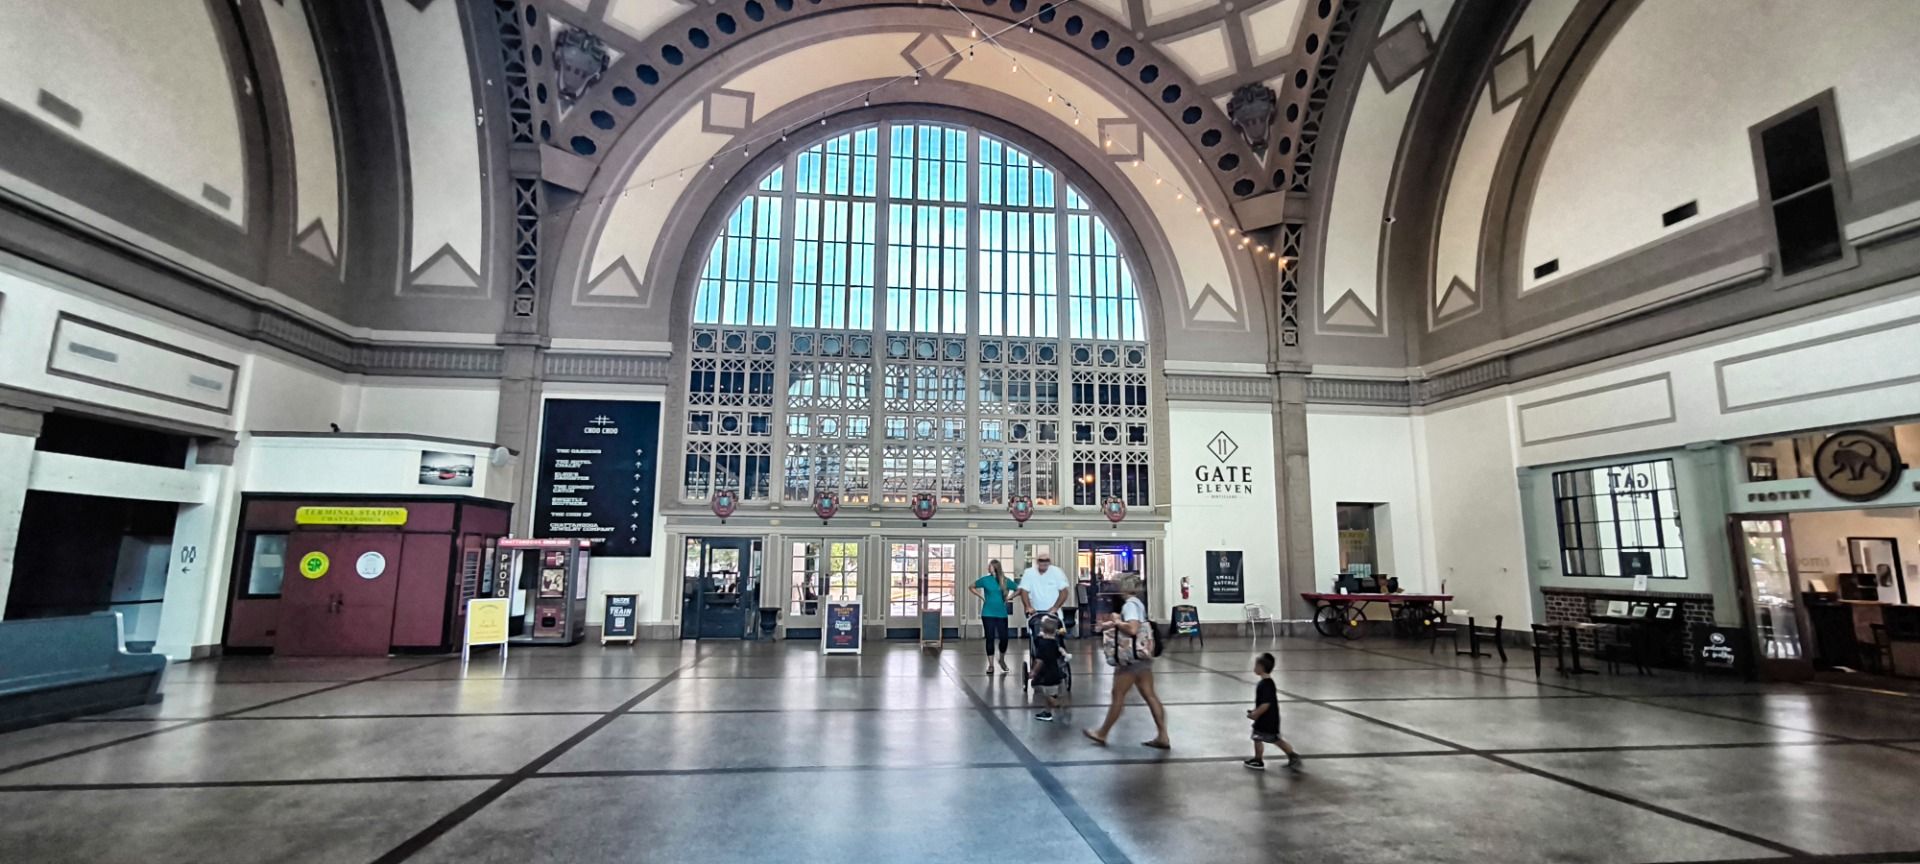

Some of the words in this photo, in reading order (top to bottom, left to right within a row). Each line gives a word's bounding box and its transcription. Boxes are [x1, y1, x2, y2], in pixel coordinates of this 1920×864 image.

[1195, 465, 1252, 482] GATE
[1197, 484, 1252, 494] ELEVEN
[1748, 489, 1811, 502] FROTHY
[498, 554, 508, 597] PHOTO
